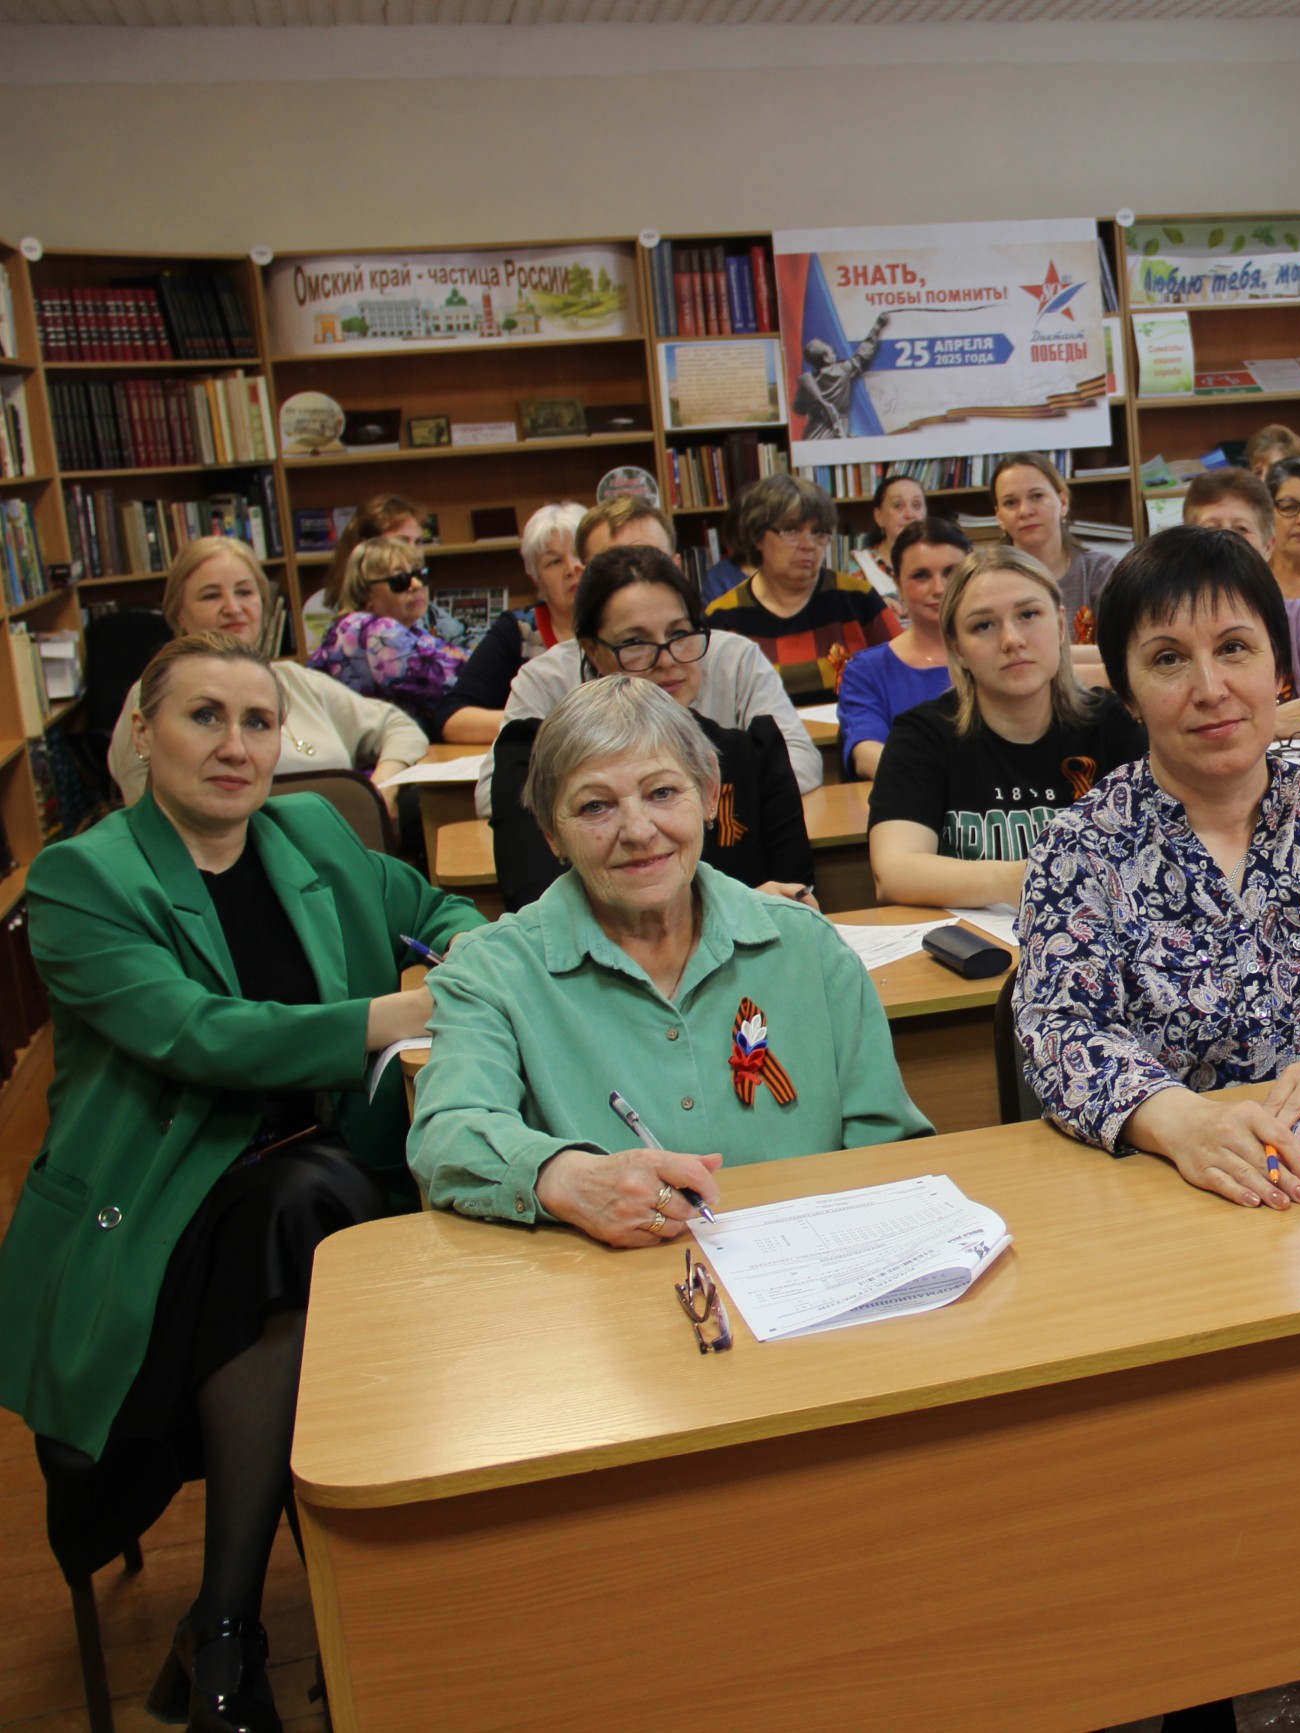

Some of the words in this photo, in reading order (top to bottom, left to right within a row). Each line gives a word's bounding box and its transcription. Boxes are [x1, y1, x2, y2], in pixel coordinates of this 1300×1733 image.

[292, 263, 364, 306] Омский
[369, 263, 412, 294] край
[427, 265, 501, 290] частица
[503, 259, 571, 294] России
[836, 263, 927, 288] ЗНАТЬ,
[1143, 265, 1204, 295] Люблю
[1210, 260, 1267, 292] тебя,
[865, 291, 922, 306] ЧТОБЫ
[925, 286, 1009, 304] ПОМНИТЬ!
[1029, 329, 1086, 343] Диктант
[894, 339, 930, 368] 25
[933, 337, 995, 354] АПРЕЛЯ
[934, 354, 963, 366] 2025
[964, 352, 995, 365] ГОДА
[1030, 342, 1088, 363] ПОБЕДЫ
